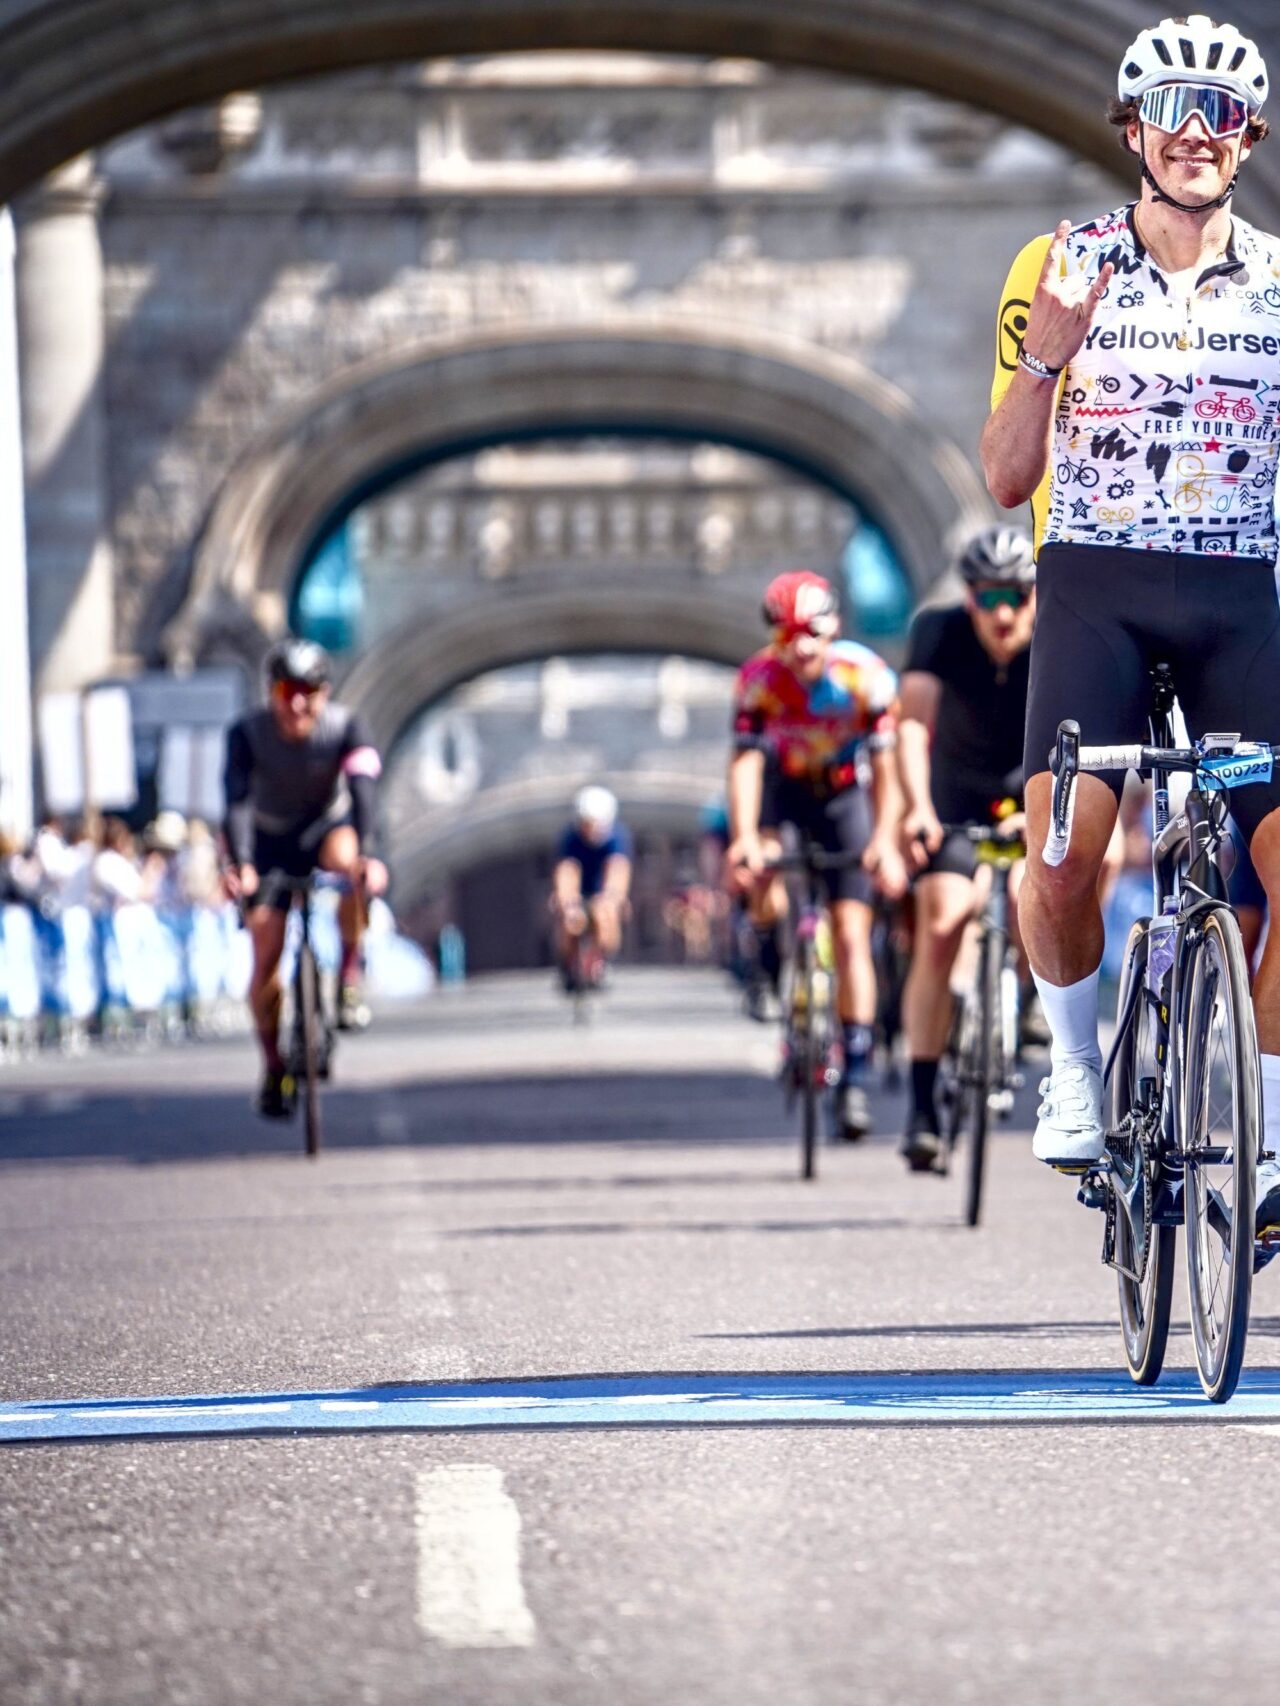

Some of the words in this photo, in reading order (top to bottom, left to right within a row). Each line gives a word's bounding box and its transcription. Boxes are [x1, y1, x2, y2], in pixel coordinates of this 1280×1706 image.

[1144, 420, 1183, 433] FREE
[1192, 421, 1233, 437] YOUR
[1242, 425, 1268, 440] RIDE
